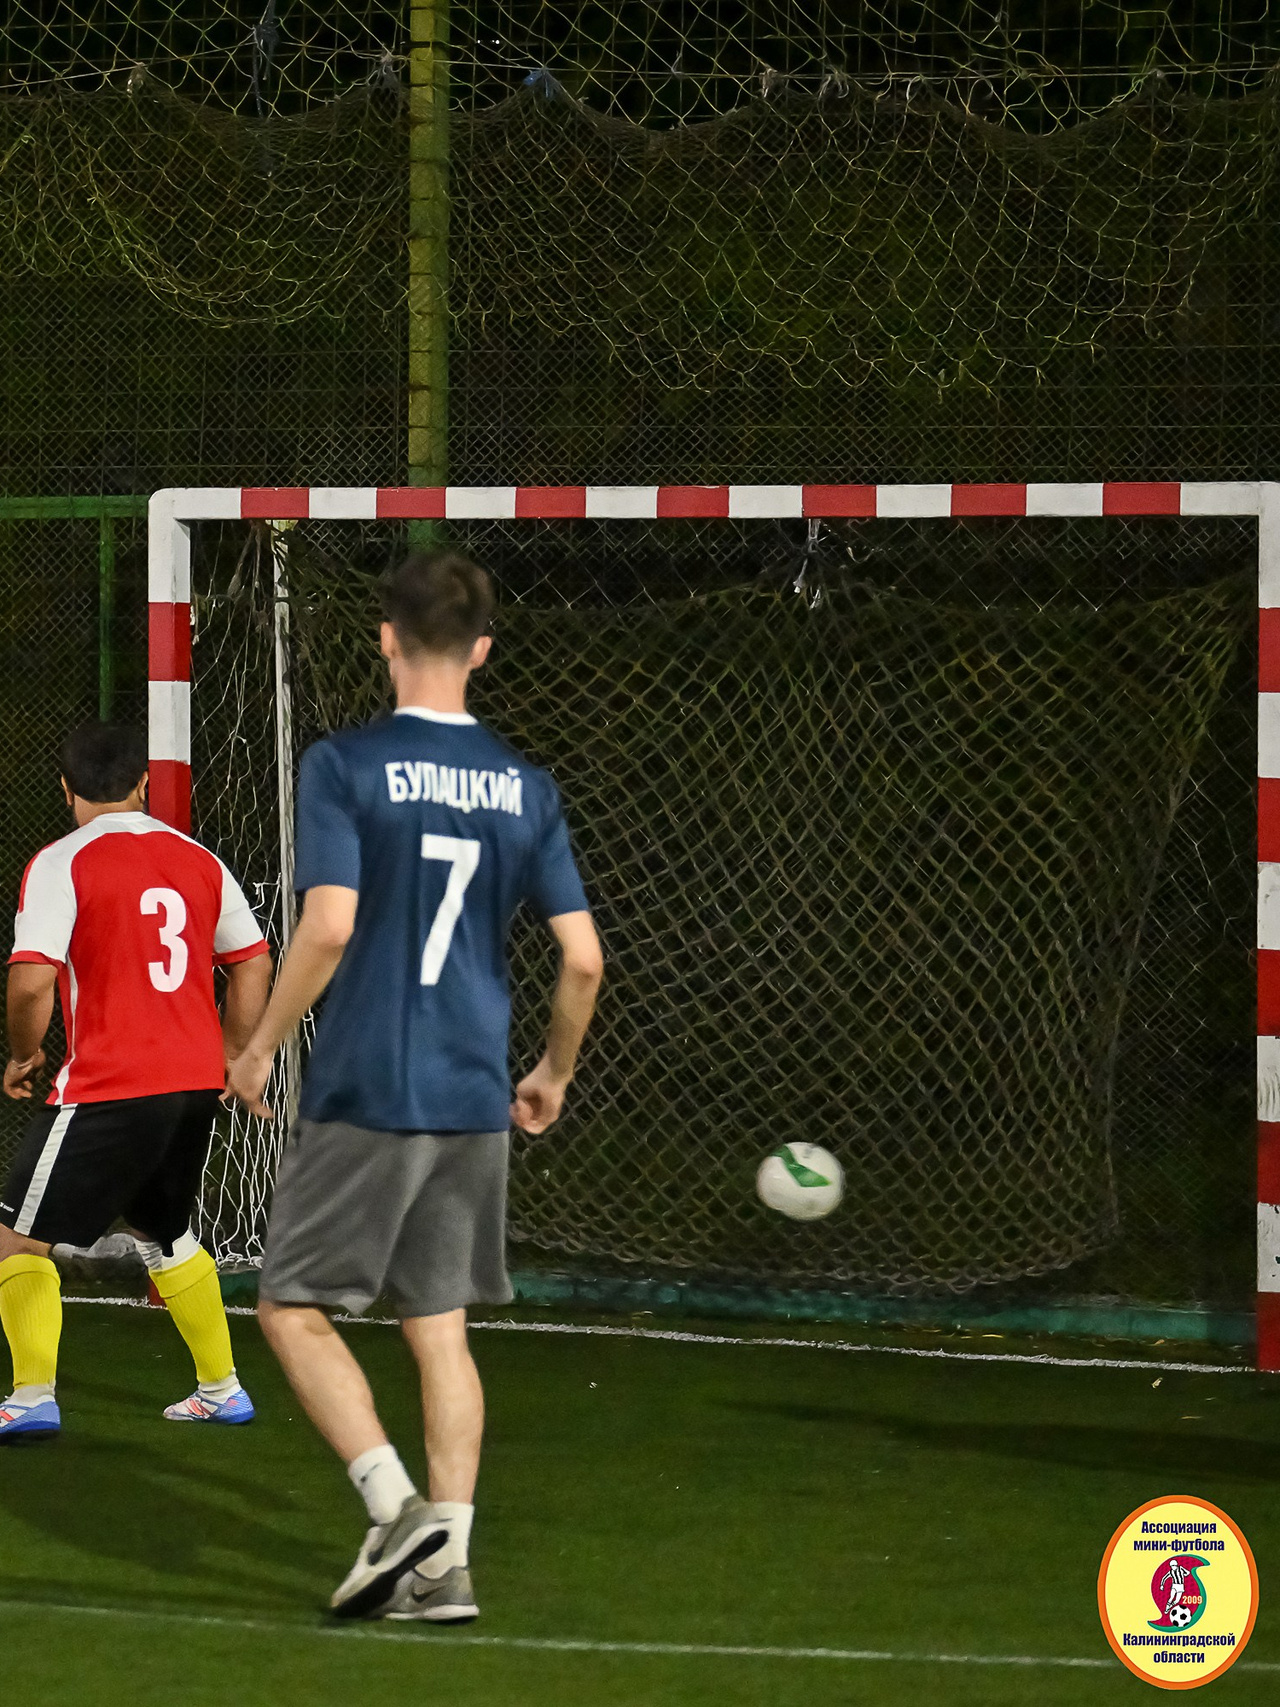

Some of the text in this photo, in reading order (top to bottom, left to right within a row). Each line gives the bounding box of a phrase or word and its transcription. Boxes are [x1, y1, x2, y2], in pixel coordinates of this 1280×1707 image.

[384, 761, 523, 817] БУЛАЦКИЙ
[139, 887, 189, 993] 3
[420, 833, 481, 986] 7
